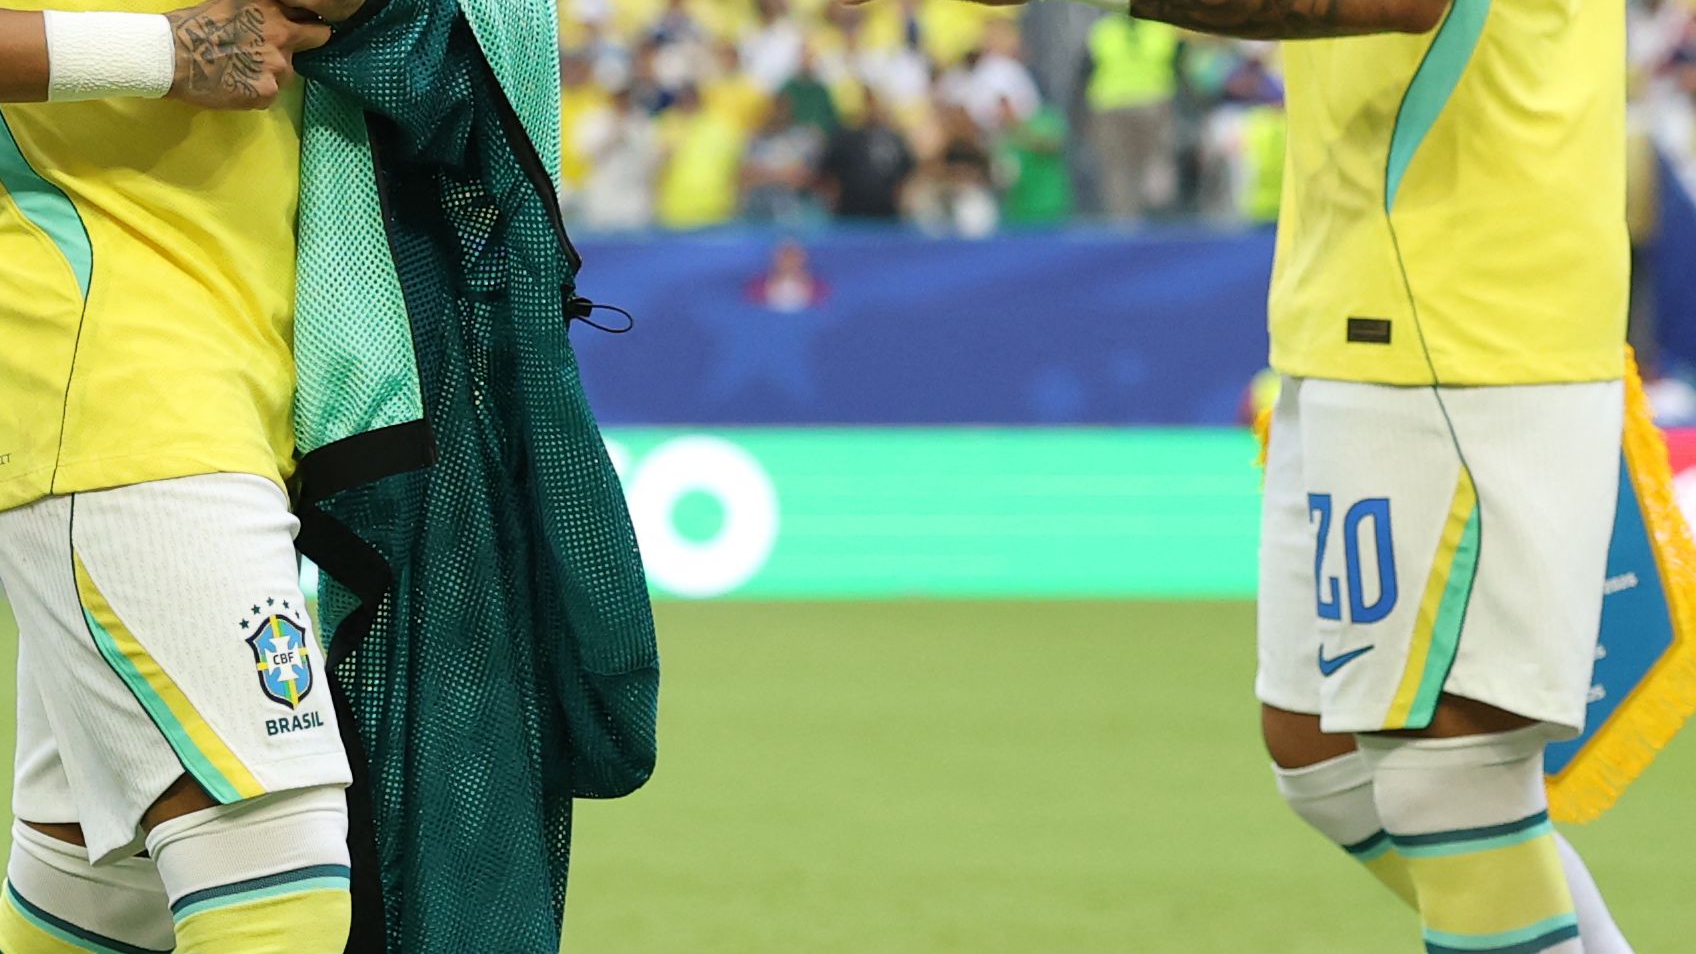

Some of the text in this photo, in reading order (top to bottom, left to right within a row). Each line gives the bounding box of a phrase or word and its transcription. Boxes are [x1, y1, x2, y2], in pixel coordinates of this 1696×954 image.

[1307, 492, 1399, 624] 20
[273, 651, 295, 666] CBF
[265, 711, 324, 736] BRASIL
